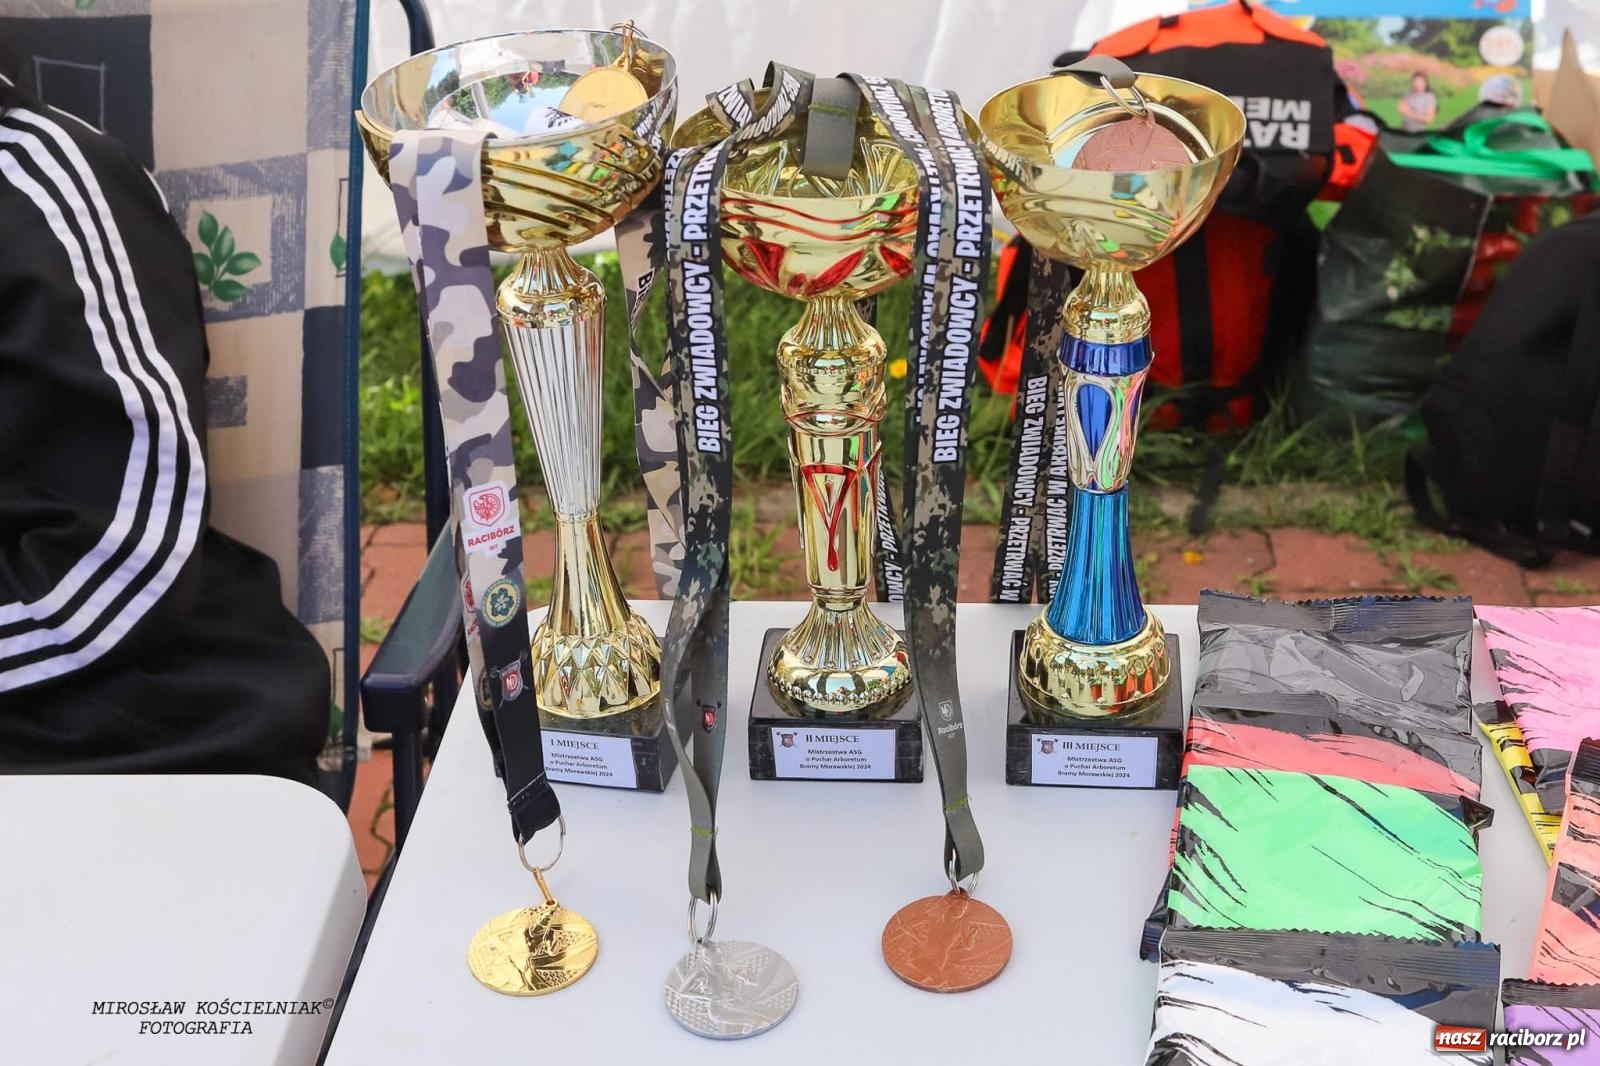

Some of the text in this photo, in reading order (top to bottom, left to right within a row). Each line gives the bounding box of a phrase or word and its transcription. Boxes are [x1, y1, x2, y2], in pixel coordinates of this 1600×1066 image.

[939, 145, 984, 258] PRZETRWAĆ
[683, 261, 718, 401] ZWIADOWCY
[939, 276, 978, 410] ZWIADOWCY
[1024, 375, 1048, 415] BIEG
[696, 405, 721, 453] BIEG
[934, 415, 959, 463] BIEG
[1012, 416, 1044, 507] ZWIADOWCY
[467, 525, 516, 548] RACIBÓRZ
[1001, 517, 1031, 588] PRZETRWAĆ
[999, 588, 1022, 602] W
[557, 739, 600, 750] MIEJSCE
[815, 735, 860, 744] MIEJSCE
[1062, 741, 1121, 752] III MIEJSCE
[551, 753, 589, 761] Mistrzostwa
[564, 768, 598, 777] Morawskiej
[576, 761, 608, 769] Arboretum
